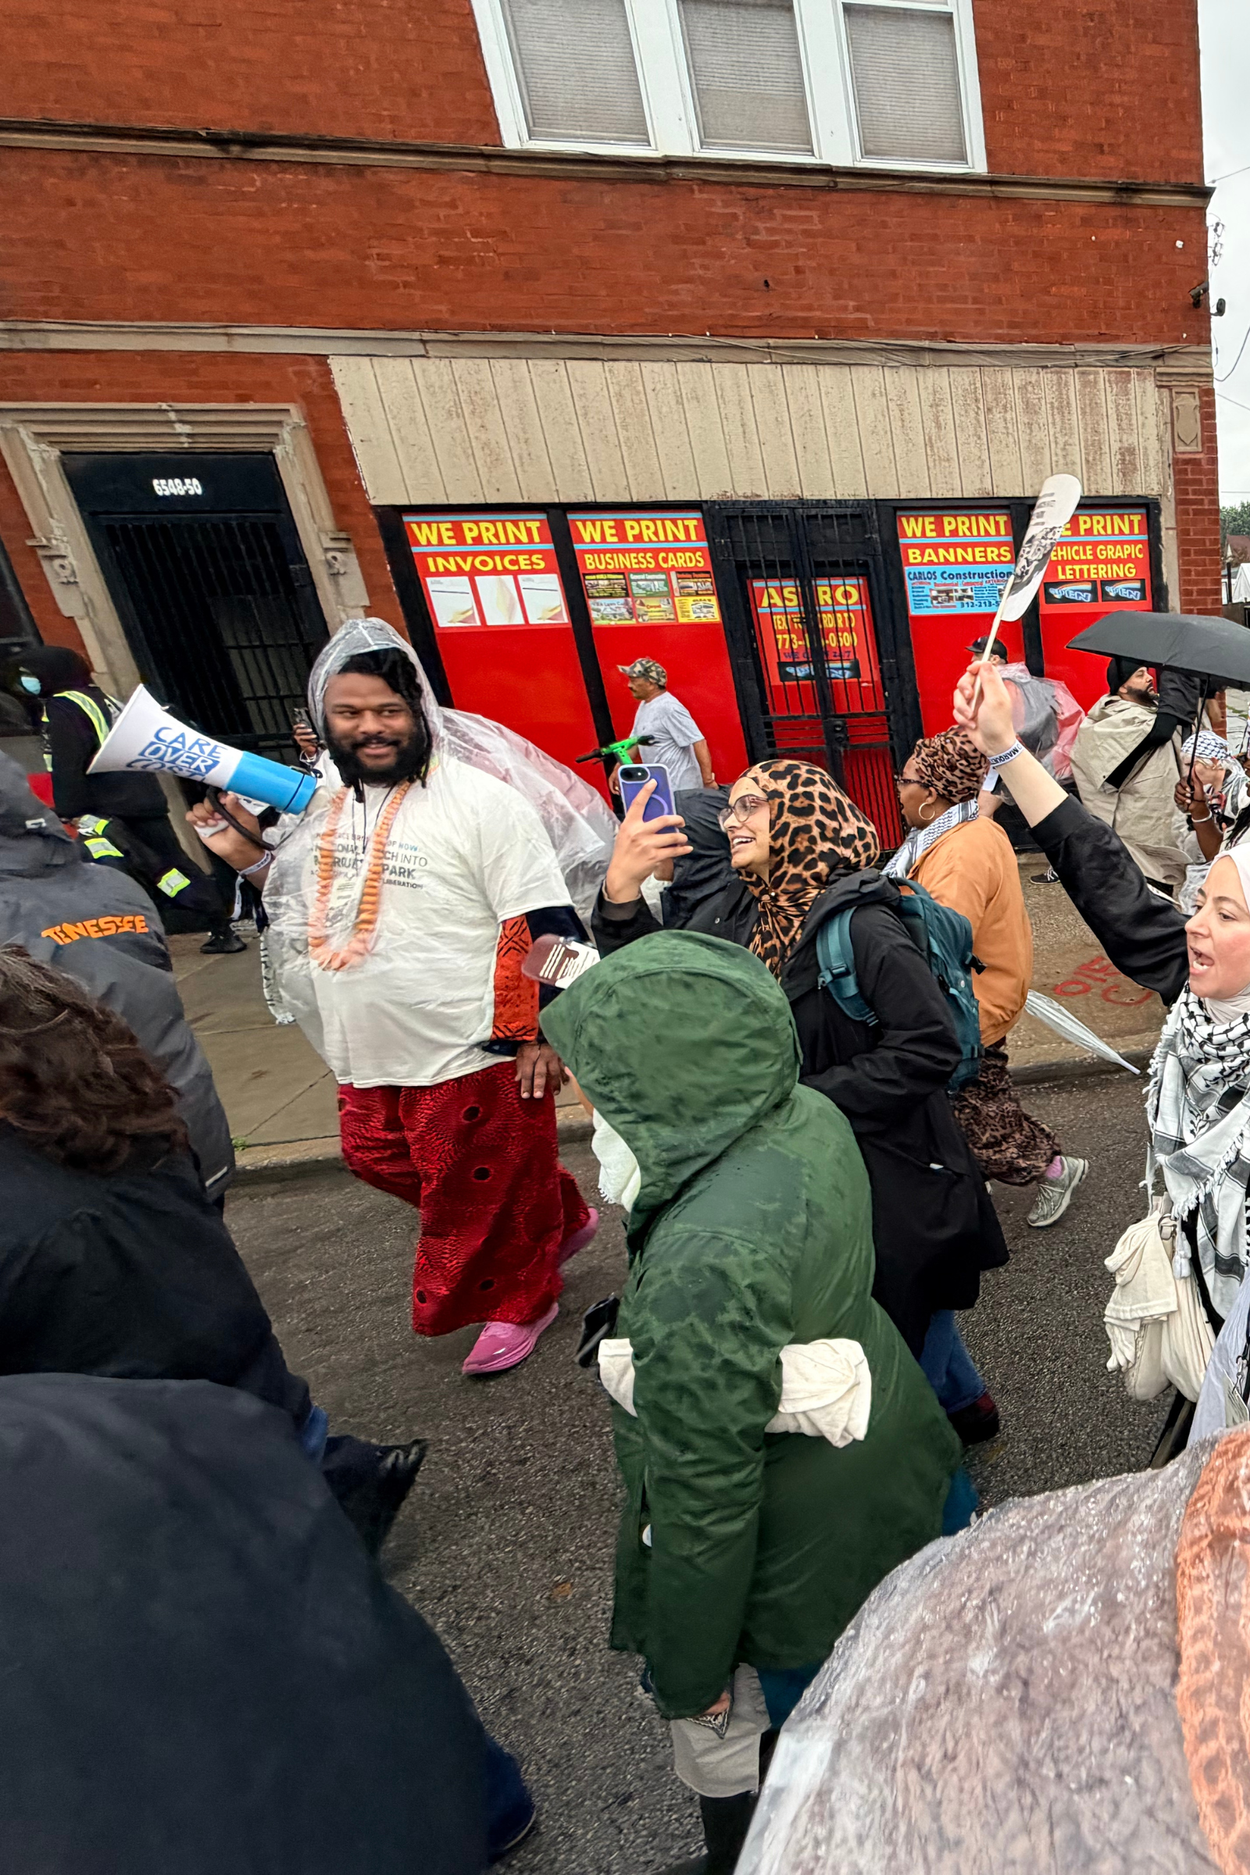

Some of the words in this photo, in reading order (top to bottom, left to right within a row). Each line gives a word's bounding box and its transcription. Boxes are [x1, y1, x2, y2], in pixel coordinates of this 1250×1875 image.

[152, 478, 203, 496] 6548-50
[411, 523, 457, 546] WE
[463, 520, 541, 545] PRINT
[576, 520, 618, 543] WE
[626, 518, 699, 543] PRINT
[901, 516, 937, 538] WE
[943, 514, 1009, 537] PRINT
[1079, 514, 1142, 536] PRINT
[584, 551, 656, 571] BUSINESS
[658, 550, 705, 569] CARDS
[907, 546, 1012, 564] BANNERS
[1050, 545, 1094, 561] EHICLE
[1096, 543, 1144, 560] GRAPIC
[427, 553, 546, 573] INVOICES
[1057, 563, 1137, 580] LETTERING
[907, 571, 938, 581] CARLOS
[940, 568, 1013, 581] Construction
[760, 585, 860, 608] ASRO
[153, 726, 228, 759] CARE
[143, 743, 215, 774] OVER
[400, 853, 429, 867] INTO
[382, 863, 417, 880] PARK
